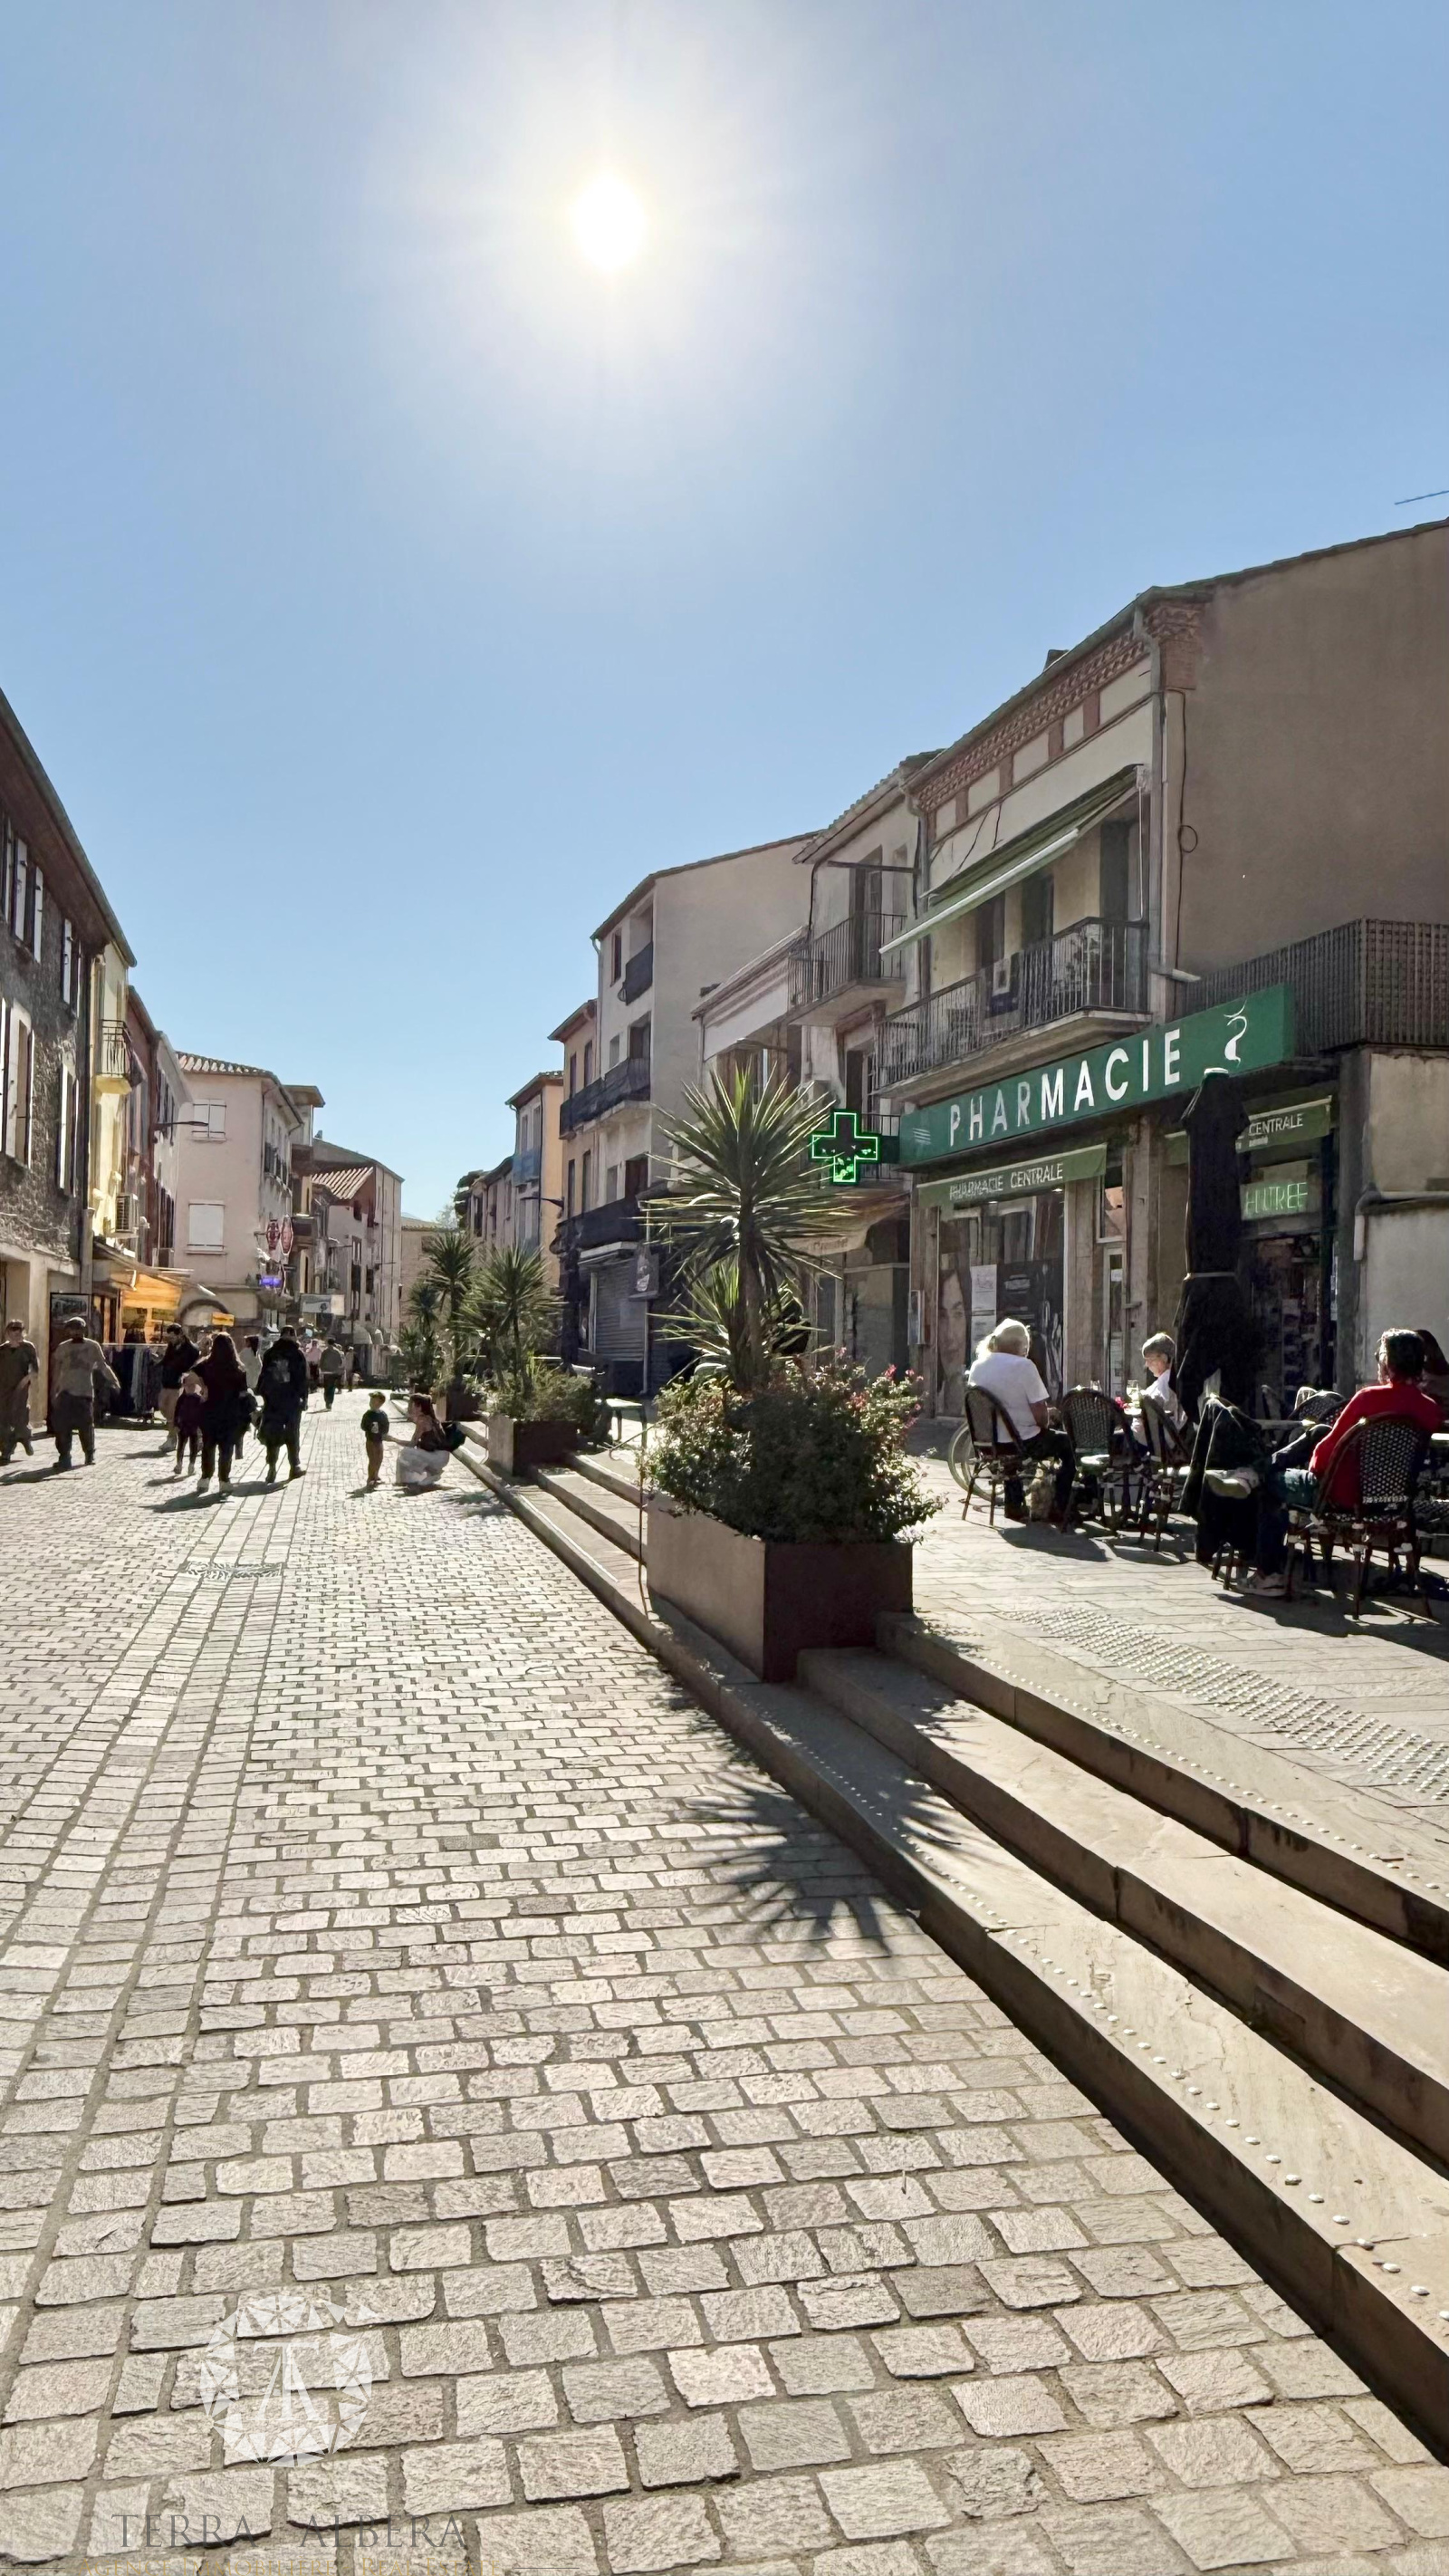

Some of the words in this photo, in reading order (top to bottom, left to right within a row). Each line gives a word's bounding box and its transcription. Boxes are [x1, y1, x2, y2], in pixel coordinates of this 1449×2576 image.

[949, 1029, 1181, 1148] PHARMACIE
[1249, 1113, 1304, 1137] CENTRALE
[1010, 1162, 1064, 1189] CENTRALE
